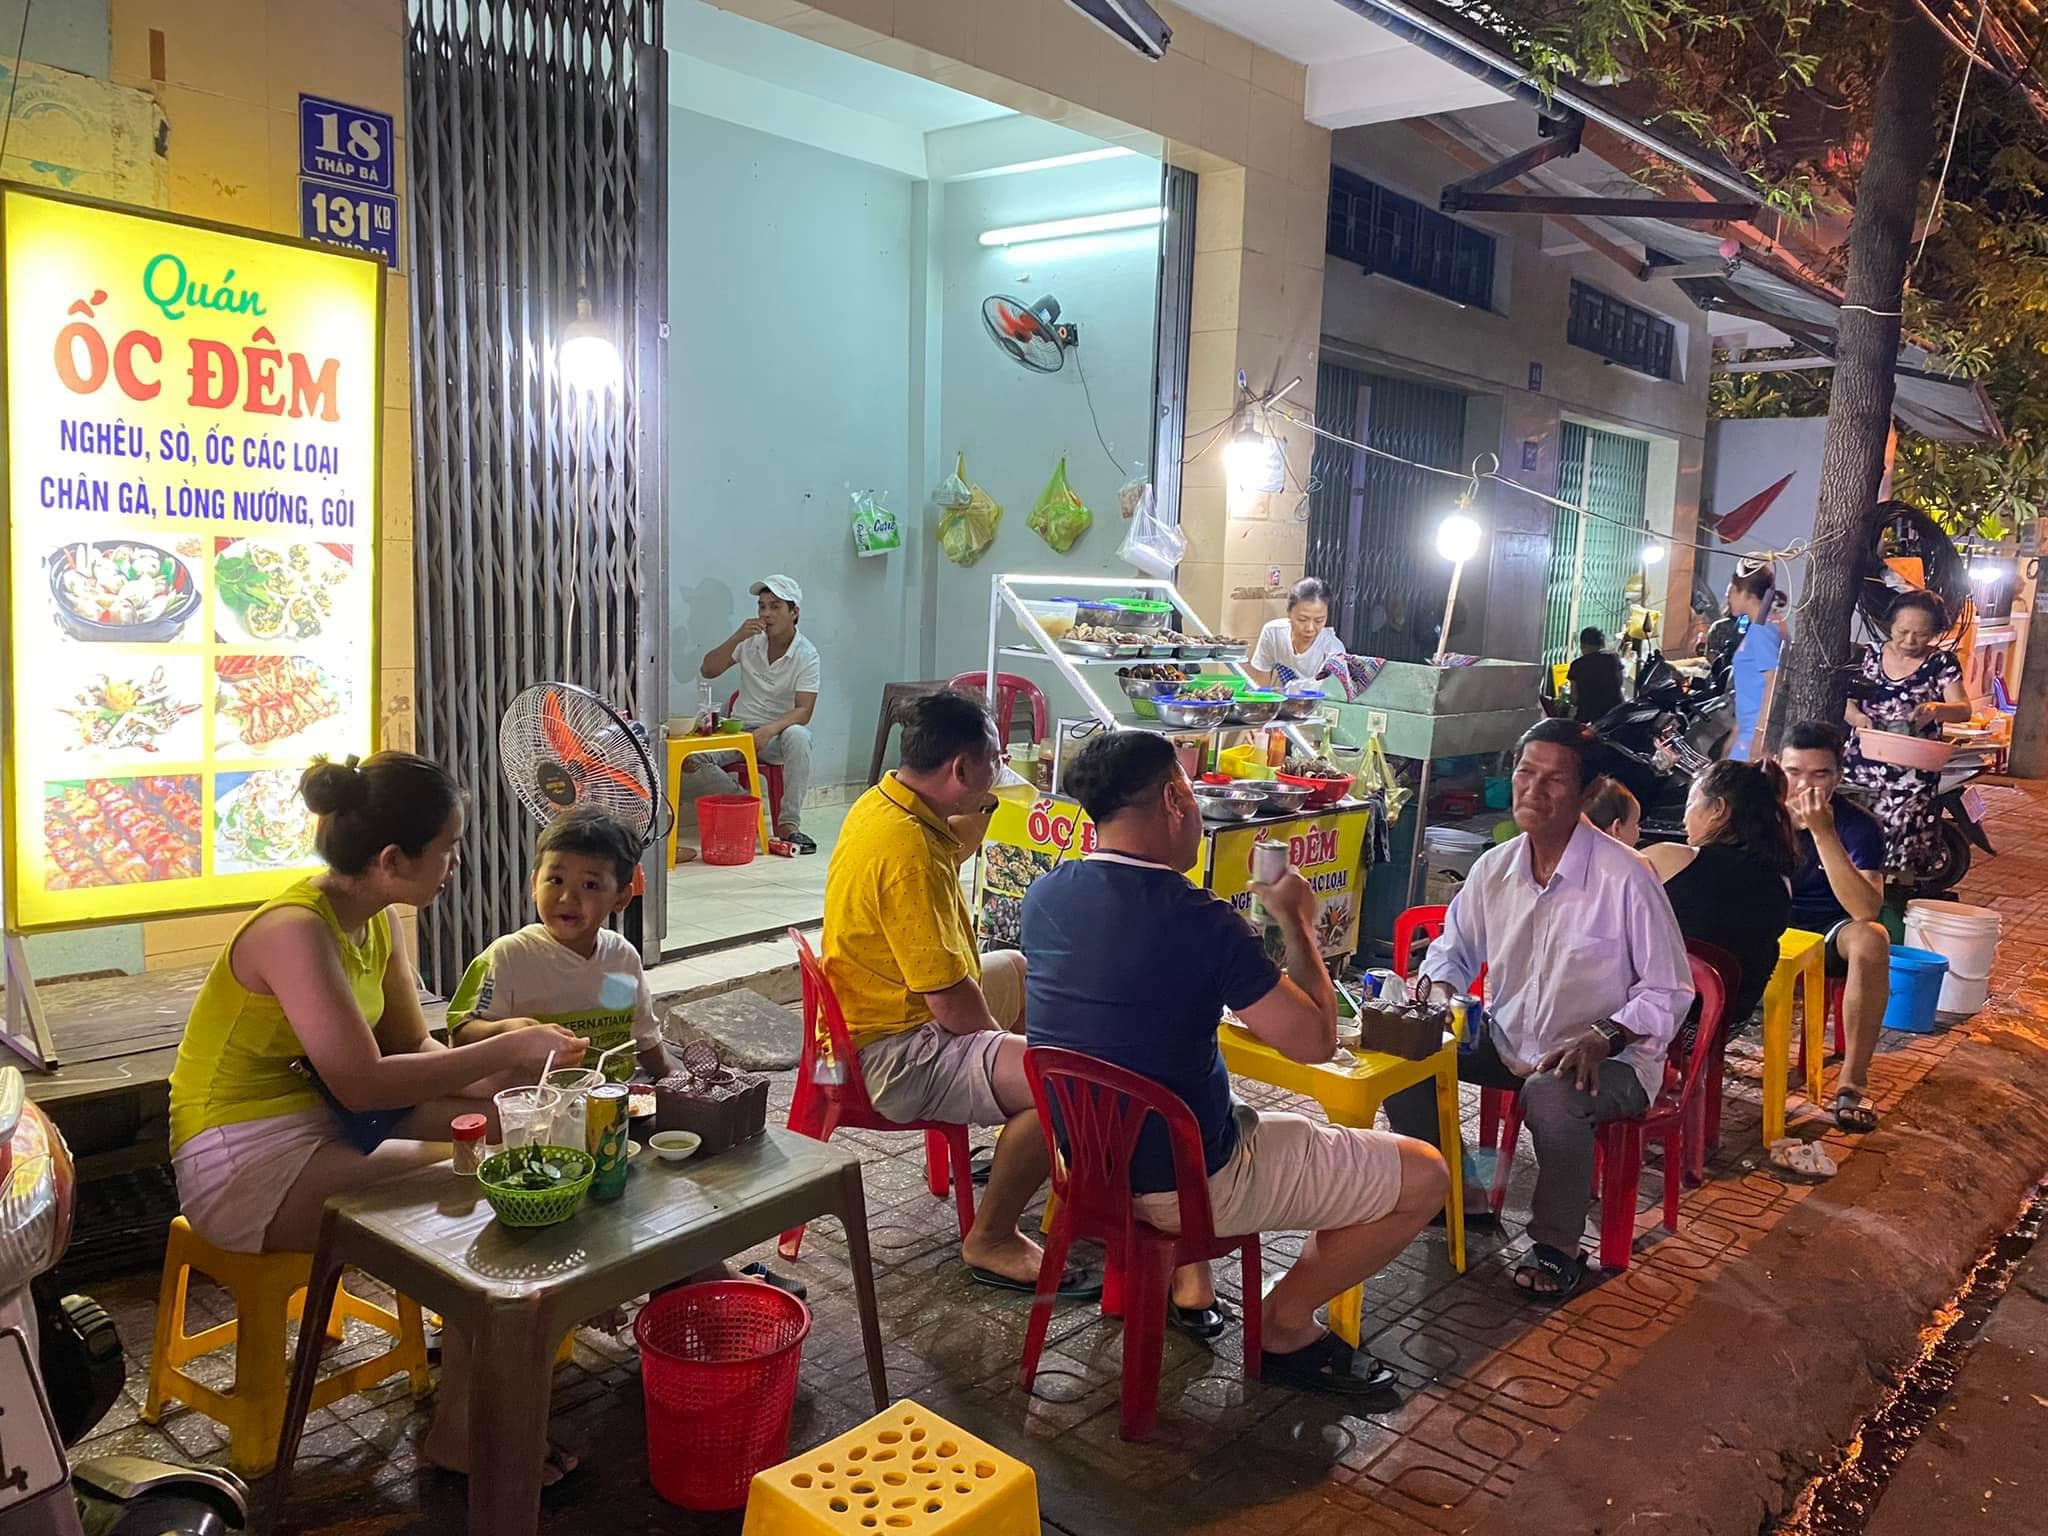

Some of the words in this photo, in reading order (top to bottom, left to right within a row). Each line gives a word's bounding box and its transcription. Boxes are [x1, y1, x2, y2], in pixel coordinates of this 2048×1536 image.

[314, 113, 381, 161] 18
[315, 156, 354, 176] THÁP
[359, 166, 379, 182] BÀ
[312, 192, 370, 241] 131
[374, 204, 391, 231] KB
[143, 253, 267, 320] Quán
[54, 289, 163, 401] ỐC
[187, 326, 341, 422] ĐÊM
[60, 418, 151, 462] NGHÊU,
[159, 422, 197, 466] SÒ,
[206, 424, 234, 466] ỐC
[243, 433, 285, 470] CÁC
[294, 442, 338, 481] LOẠI
[40, 472, 108, 512] CHÂN
[118, 476, 157, 520] GÀ,
[165, 479, 225, 520] LÒNG
[322, 489, 354, 527] GỎI
[1028, 799, 1073, 849] ỐC
[1288, 824, 1339, 868] ĐÊM
[1325, 870, 1347, 892] LOẠI
